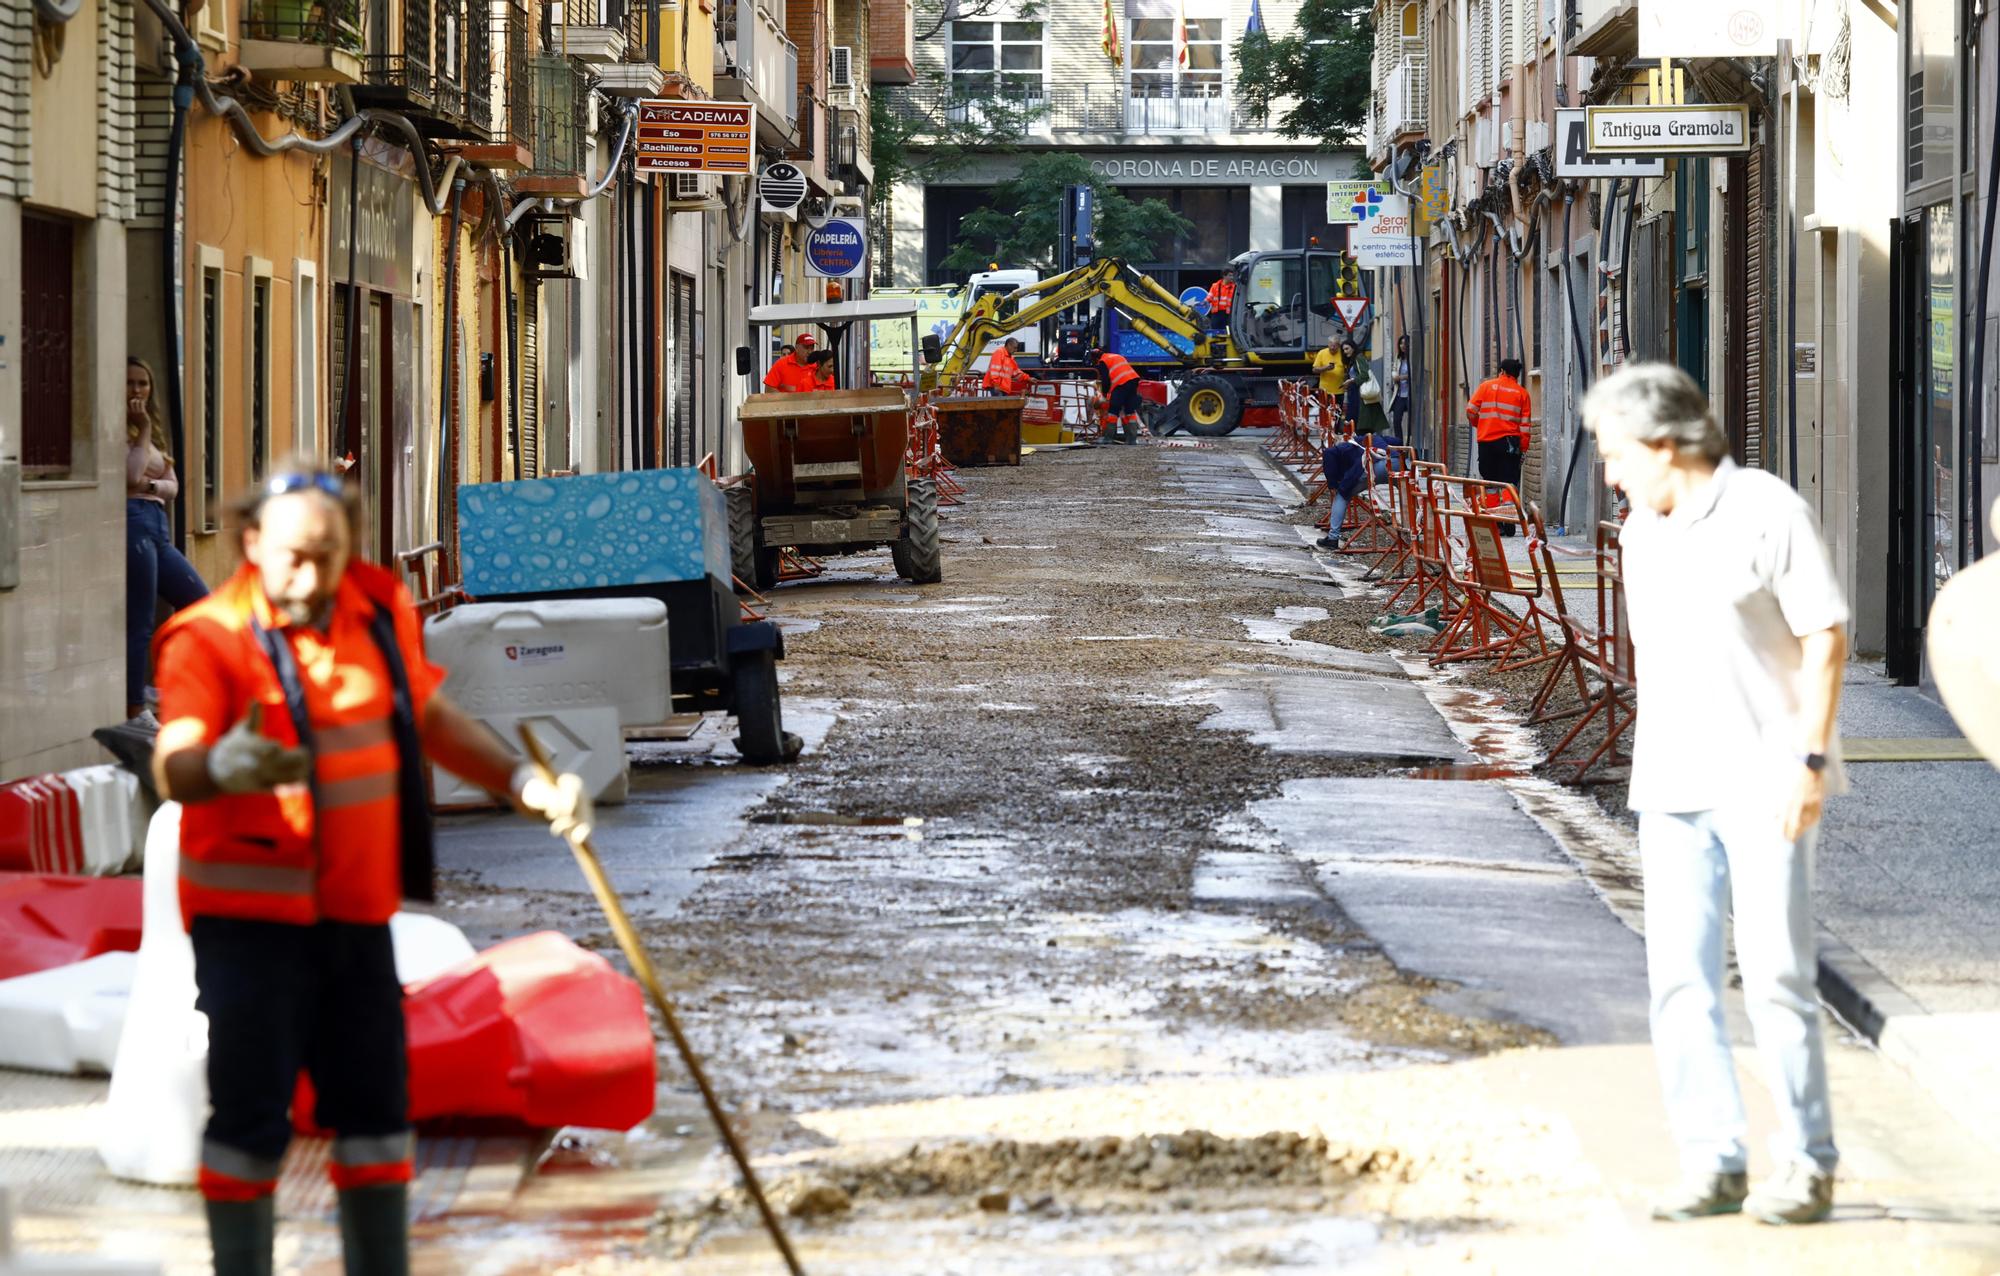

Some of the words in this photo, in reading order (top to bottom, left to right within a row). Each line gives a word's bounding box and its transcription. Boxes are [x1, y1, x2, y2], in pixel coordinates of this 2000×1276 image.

[662, 129, 680, 138] Eso
[1602, 121, 1661, 141] Antigua
[1668, 119, 1734, 136] Gramola
[643, 143, 699, 153] Bachillerato
[651, 158, 690, 167] Accesos
[1090, 159, 1184, 177] CORONA
[1190, 159, 1220, 177] DE
[1226, 155, 1319, 177] ARAGÓN
[1371, 224, 1404, 234] derm
[814, 231, 858, 245] PAPELERÍA
[1362, 243, 1387, 251] centro
[1375, 251, 1405, 259] estético
[520, 645, 564, 656] Zaragoza
